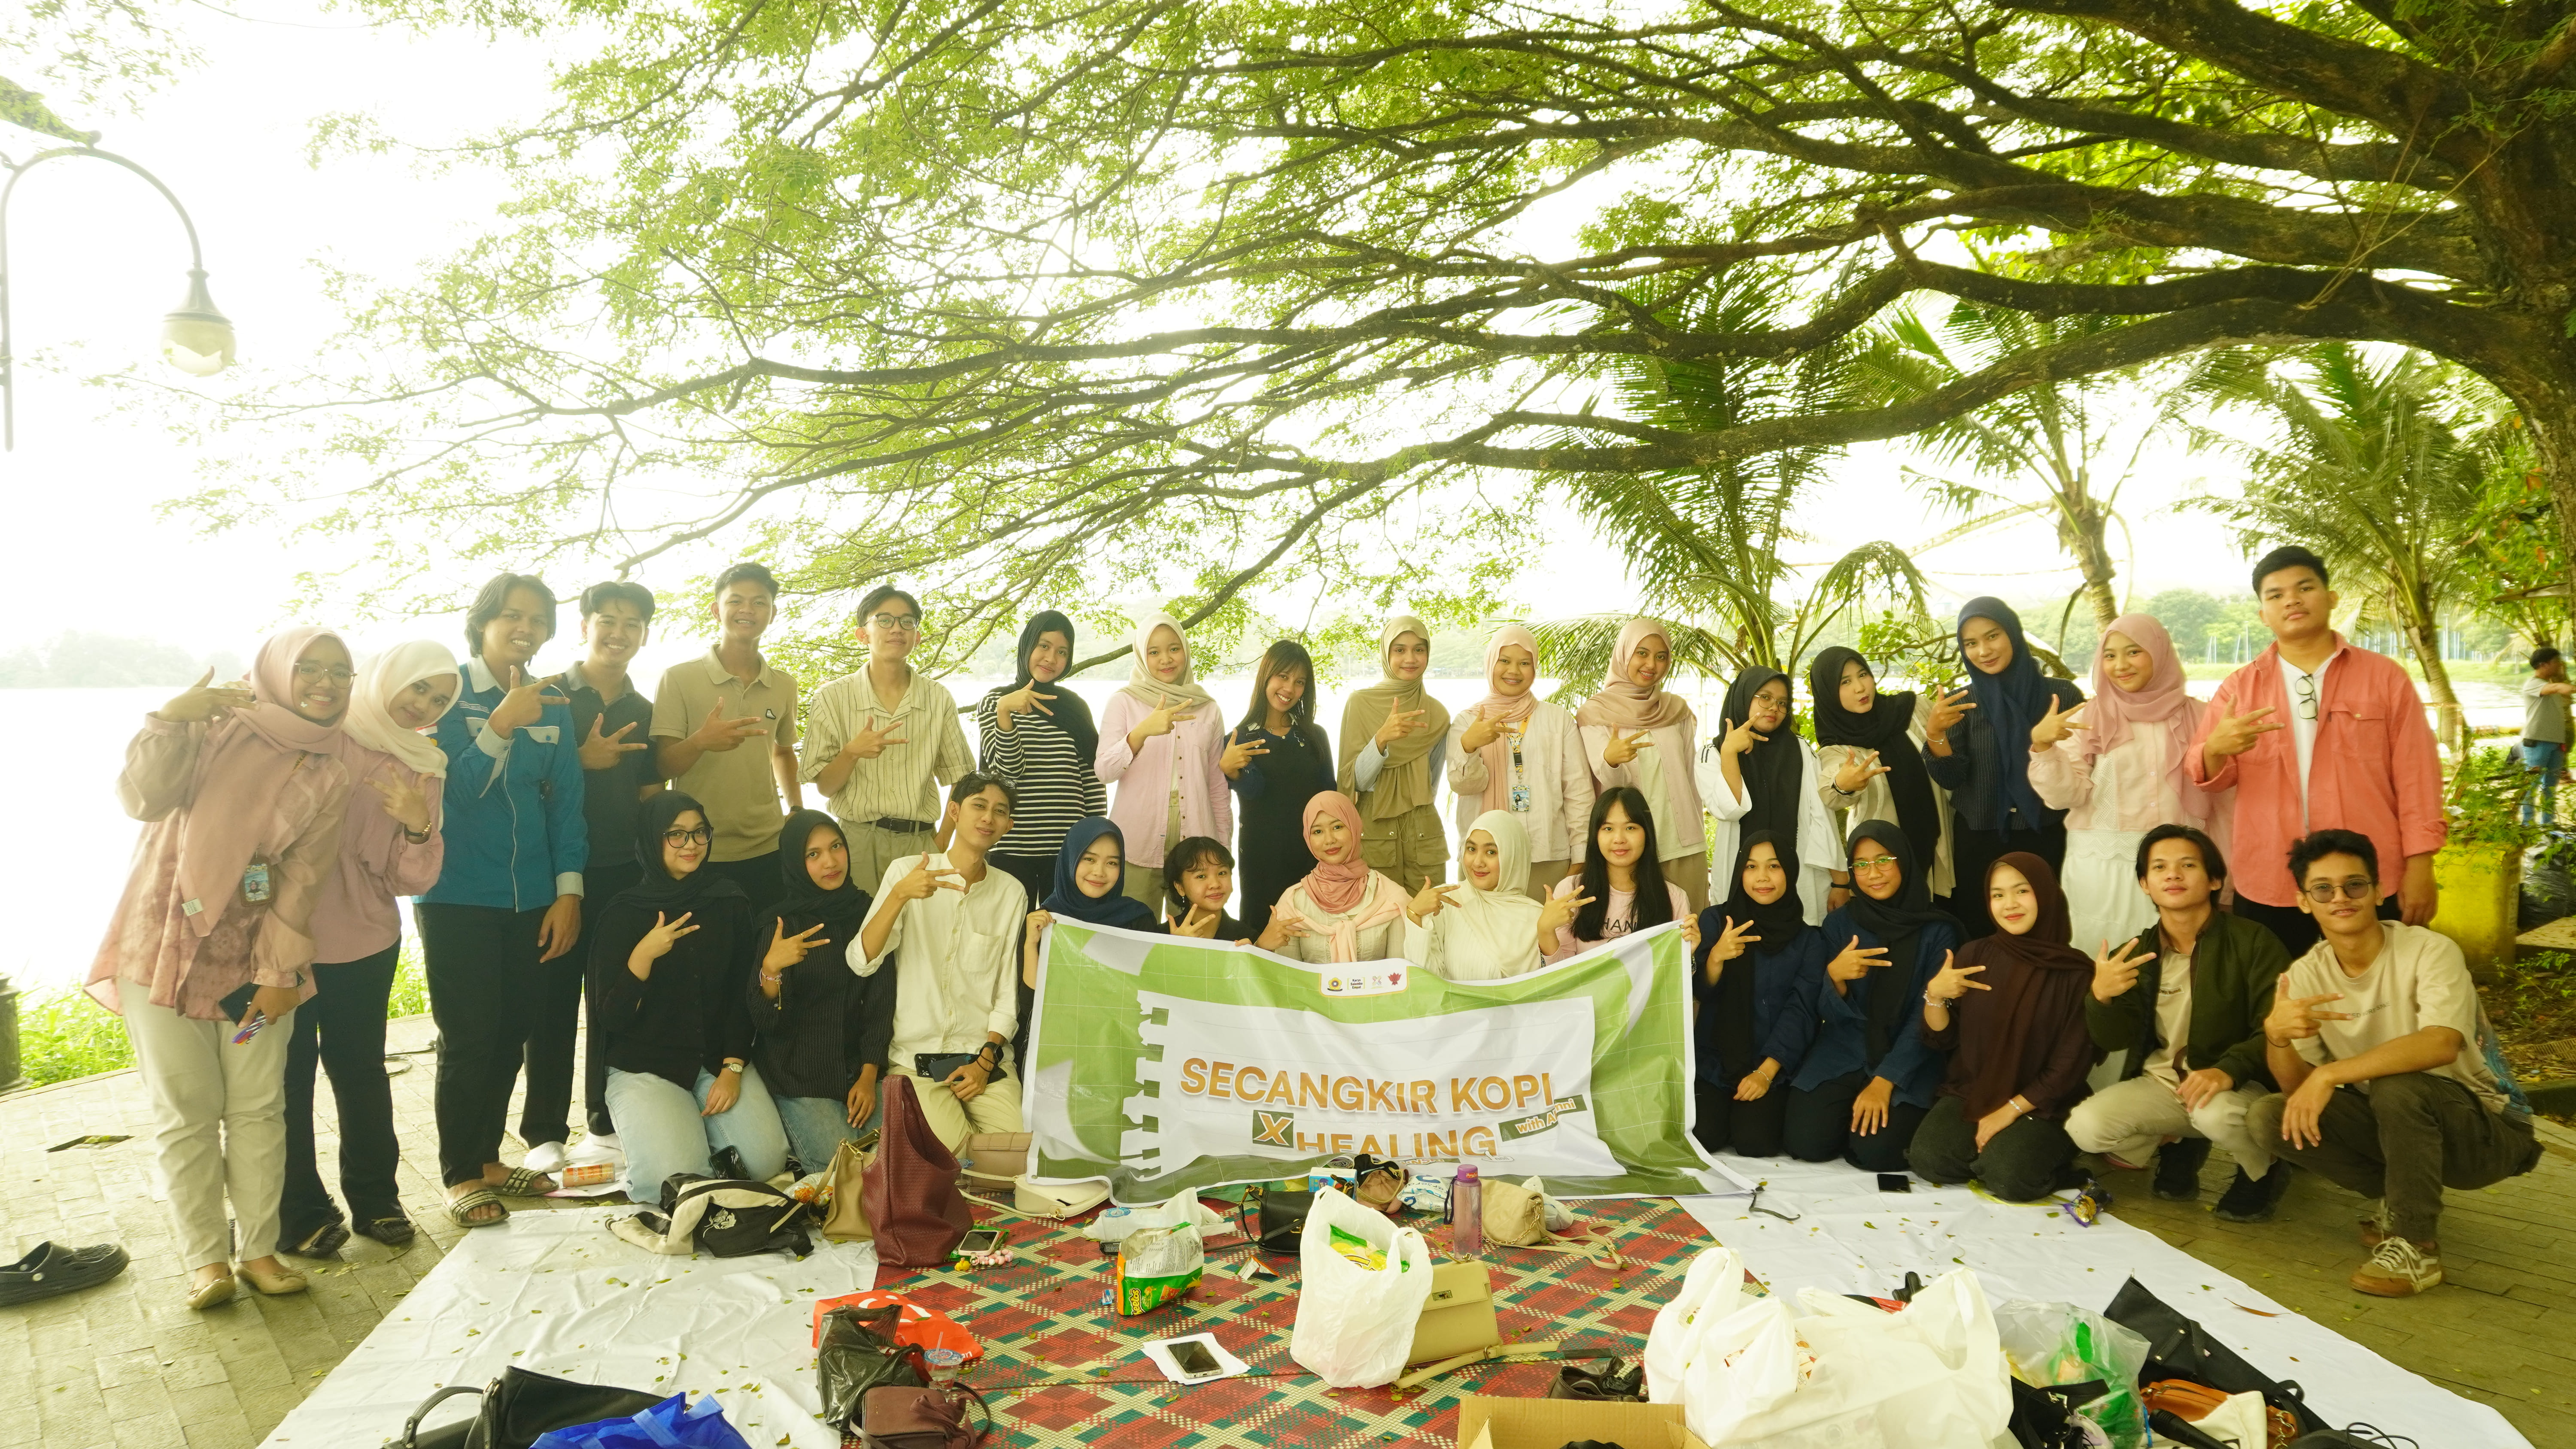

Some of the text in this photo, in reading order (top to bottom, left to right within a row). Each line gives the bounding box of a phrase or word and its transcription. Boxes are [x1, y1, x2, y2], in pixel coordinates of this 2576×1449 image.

[1180, 1058, 1553, 1113] SECANGKIR KOPI
[1255, 1113, 1293, 1145] X
[1517, 1117, 1545, 1132] with
[1296, 1126, 1497, 1157] HEALING
[1129, 1288, 1144, 1316] heetos
